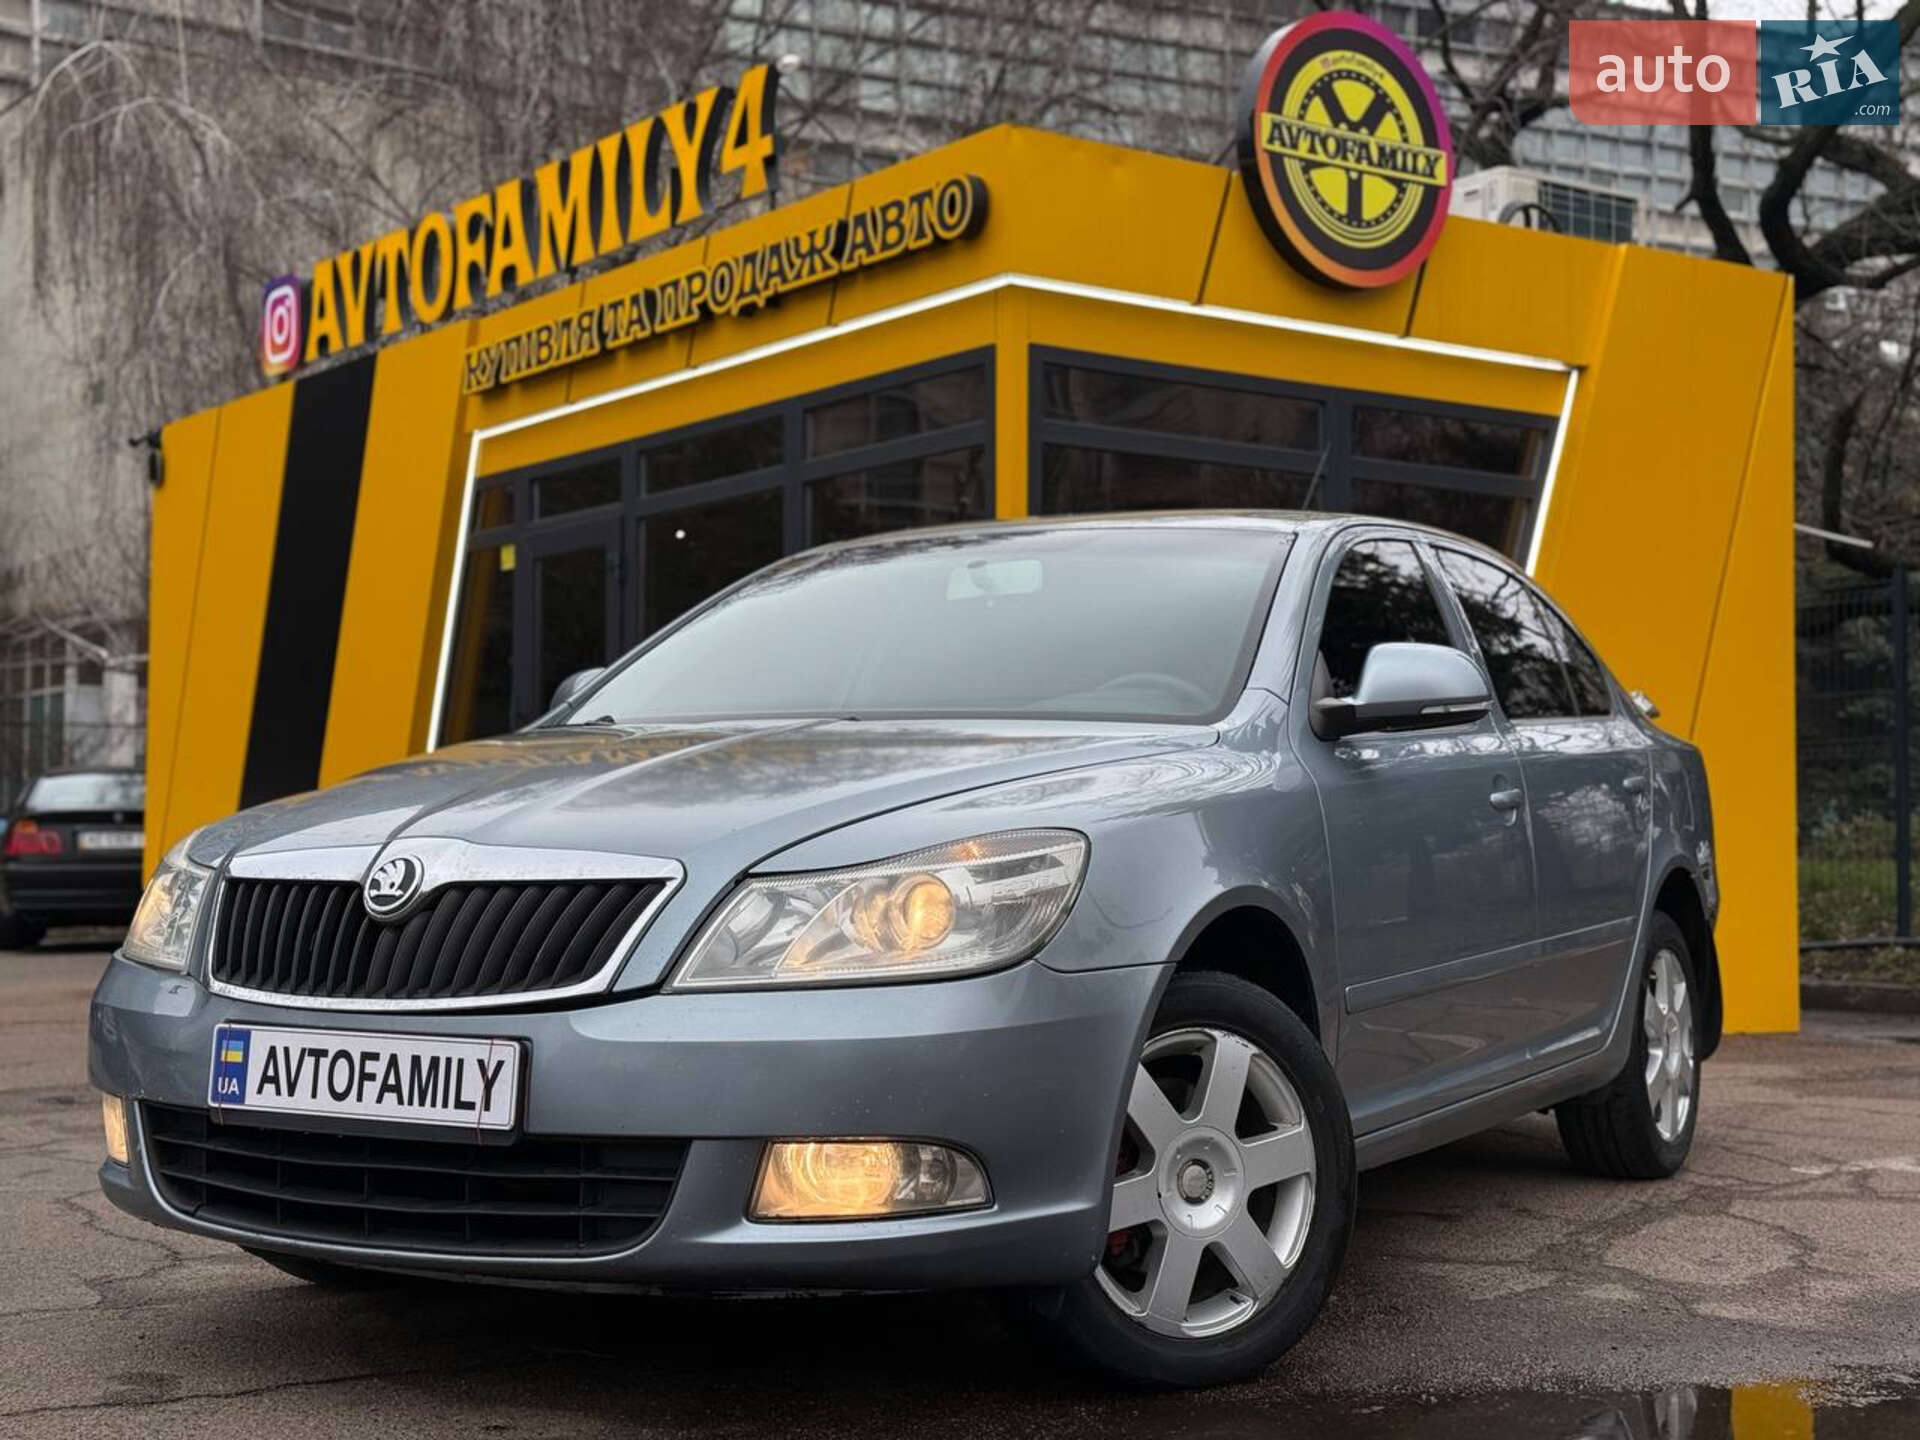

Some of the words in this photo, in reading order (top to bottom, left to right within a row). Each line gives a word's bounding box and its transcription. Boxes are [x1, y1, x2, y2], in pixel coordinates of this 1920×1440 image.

[1268, 120, 1442, 180] AVTOFAMILY
[463, 306, 600, 395] КУПІВЛЯ
[603, 287, 654, 350] ТА
[653, 221, 841, 334] ПРОДАЖ
[841, 173, 974, 272] АВТО
[218, 1076, 240, 1096] UA
[256, 1045, 505, 1112] AVTOFAMILY
